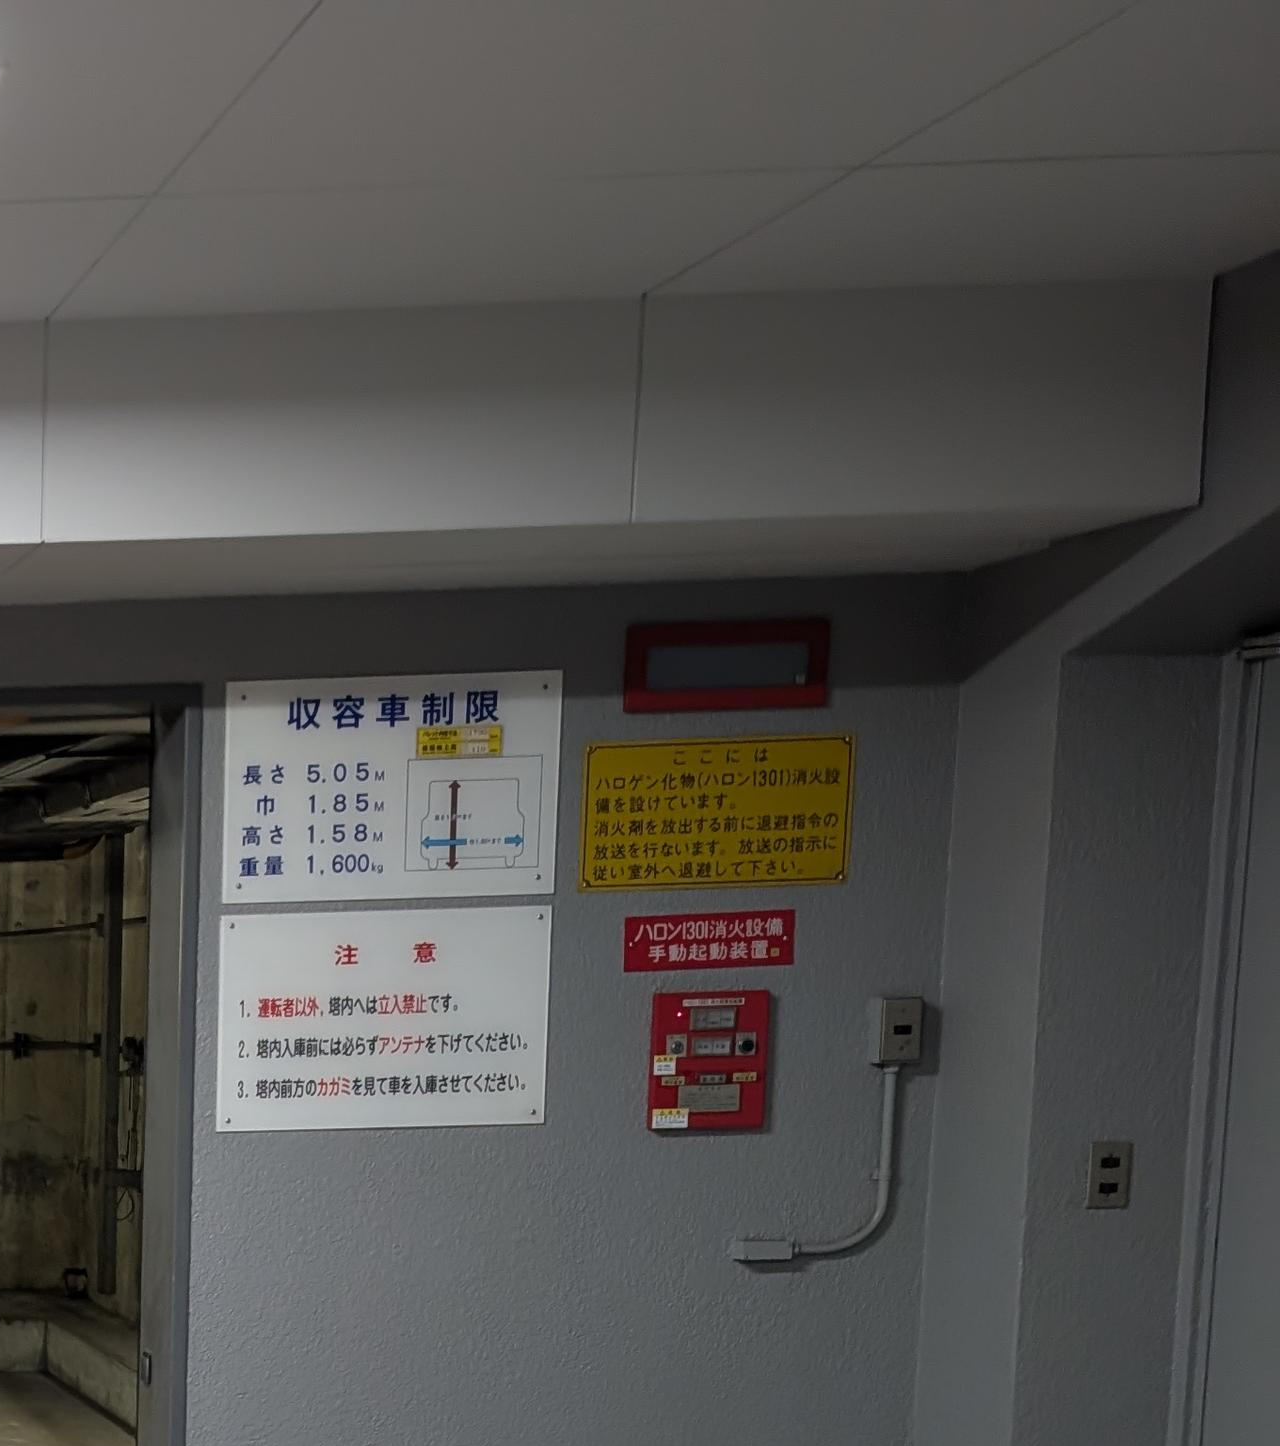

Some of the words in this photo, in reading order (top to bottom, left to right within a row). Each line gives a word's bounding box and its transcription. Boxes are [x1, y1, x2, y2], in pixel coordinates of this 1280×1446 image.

[287, 689, 499, 730] 収容車制限
[673, 748, 769, 766] ここには
[242, 763, 285, 785] 長さ
[595, 768, 840, 791] ハロゲン化物(ハロン1301)消火設
[256, 794, 276, 816] 巾
[594, 793, 737, 814] 備を設けています。
[241, 824, 285, 846] 高さ
[593, 812, 839, 837] 消火剤を放出する前に退避指令の
[239, 856, 284, 877] 重量
[592, 859, 804, 882] 従い室外へ退避して下さい。
[634, 917, 784, 942] ハロン1301消火設備
[334, 941, 438, 966] 注意
[648, 940, 769, 963] 手動起動装置
[256, 1033, 528, 1060] 塔内入庫前には必らずアンテナを下げてください。
[255, 1074, 526, 1100] 塔内前方のカガミを見て車を入庫させてください。
